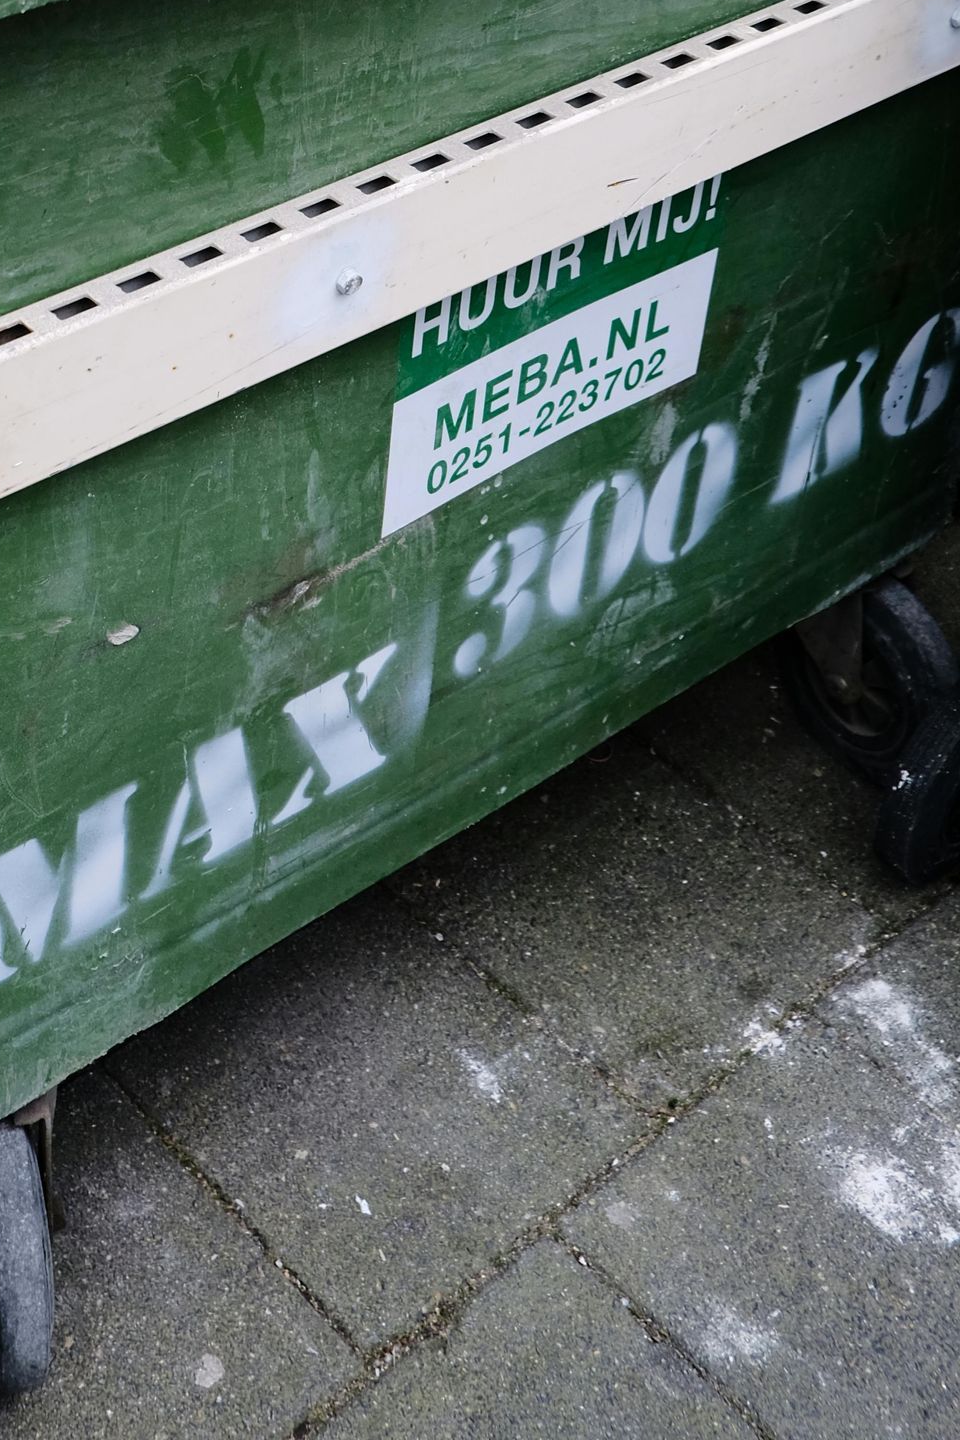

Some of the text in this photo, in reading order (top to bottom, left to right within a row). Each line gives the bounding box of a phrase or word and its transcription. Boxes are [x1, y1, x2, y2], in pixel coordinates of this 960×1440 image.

[603, 173, 722, 265] MIJ!
[426, 348, 667, 495] 0251-223702
[433, 299, 670, 451] MEBA.NL
[768, 307, 960, 503] KG
